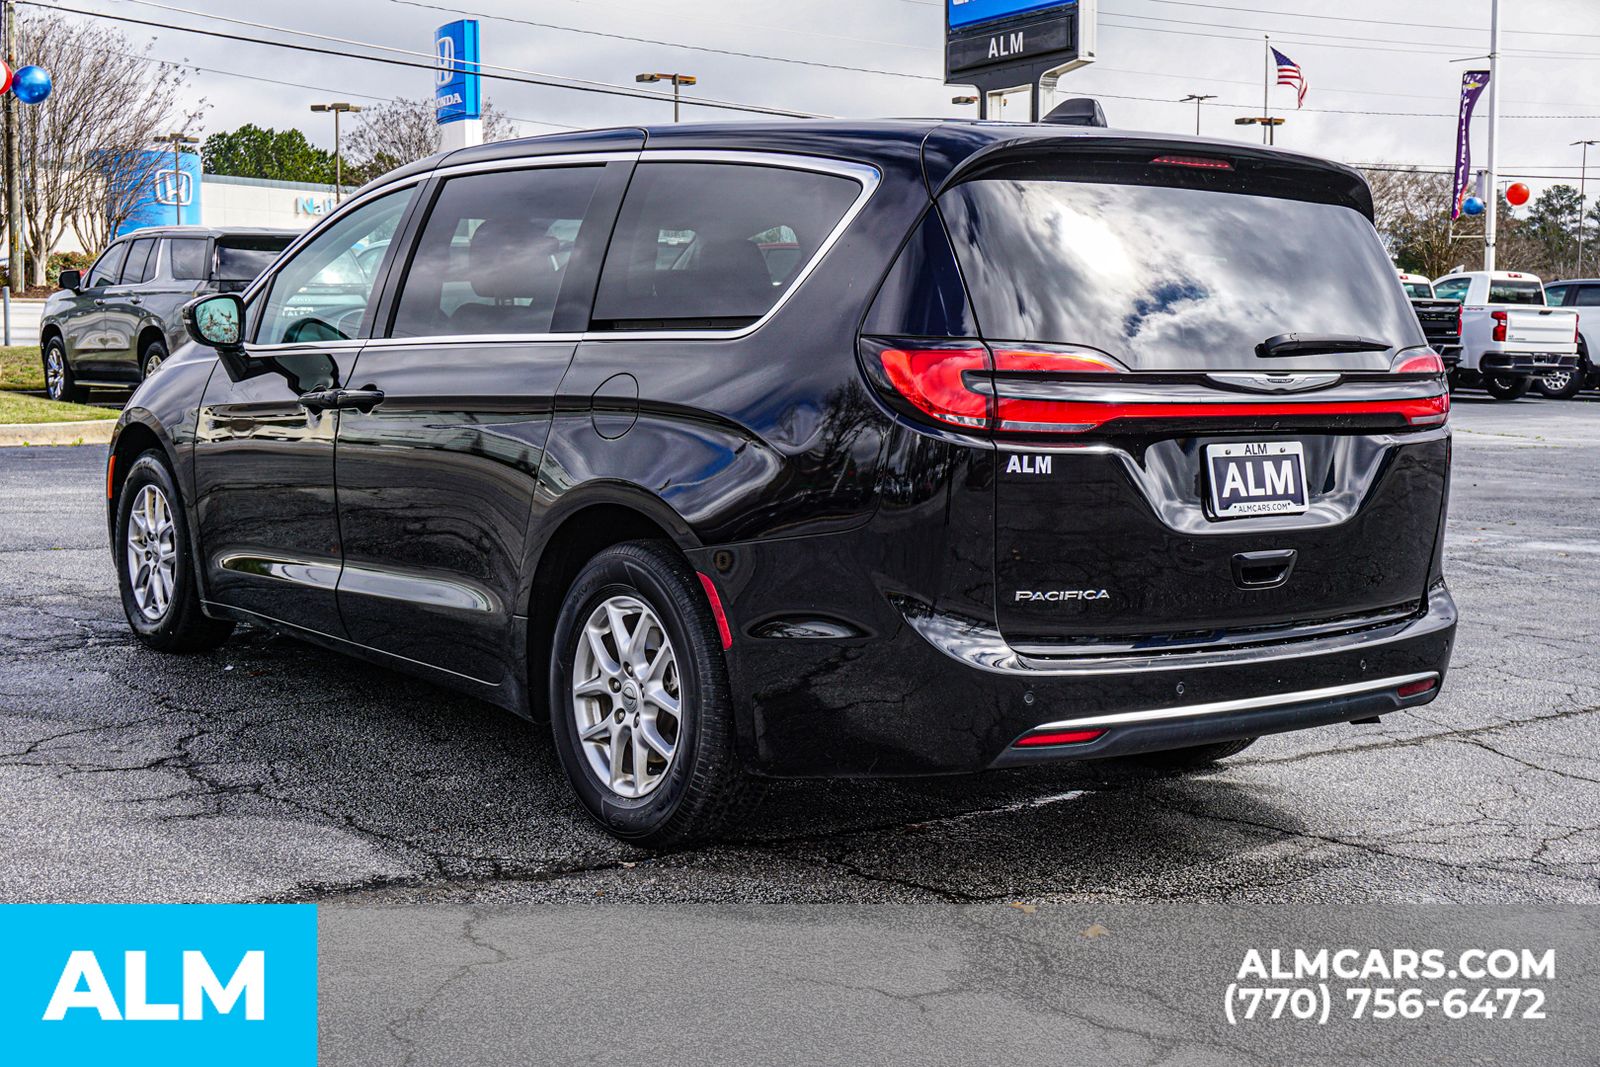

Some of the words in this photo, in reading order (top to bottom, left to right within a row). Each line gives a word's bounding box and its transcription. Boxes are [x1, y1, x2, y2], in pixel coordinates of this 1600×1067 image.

[988, 31, 1024, 59] ALM
[436, 92, 463, 109] ONDA
[1244, 443, 1268, 455] ALM
[1006, 454, 1052, 474] ALM
[1222, 460, 1295, 498] ALM
[1238, 502, 1288, 513] ALMCARS.COM
[1015, 589, 1110, 601] PACIFICA
